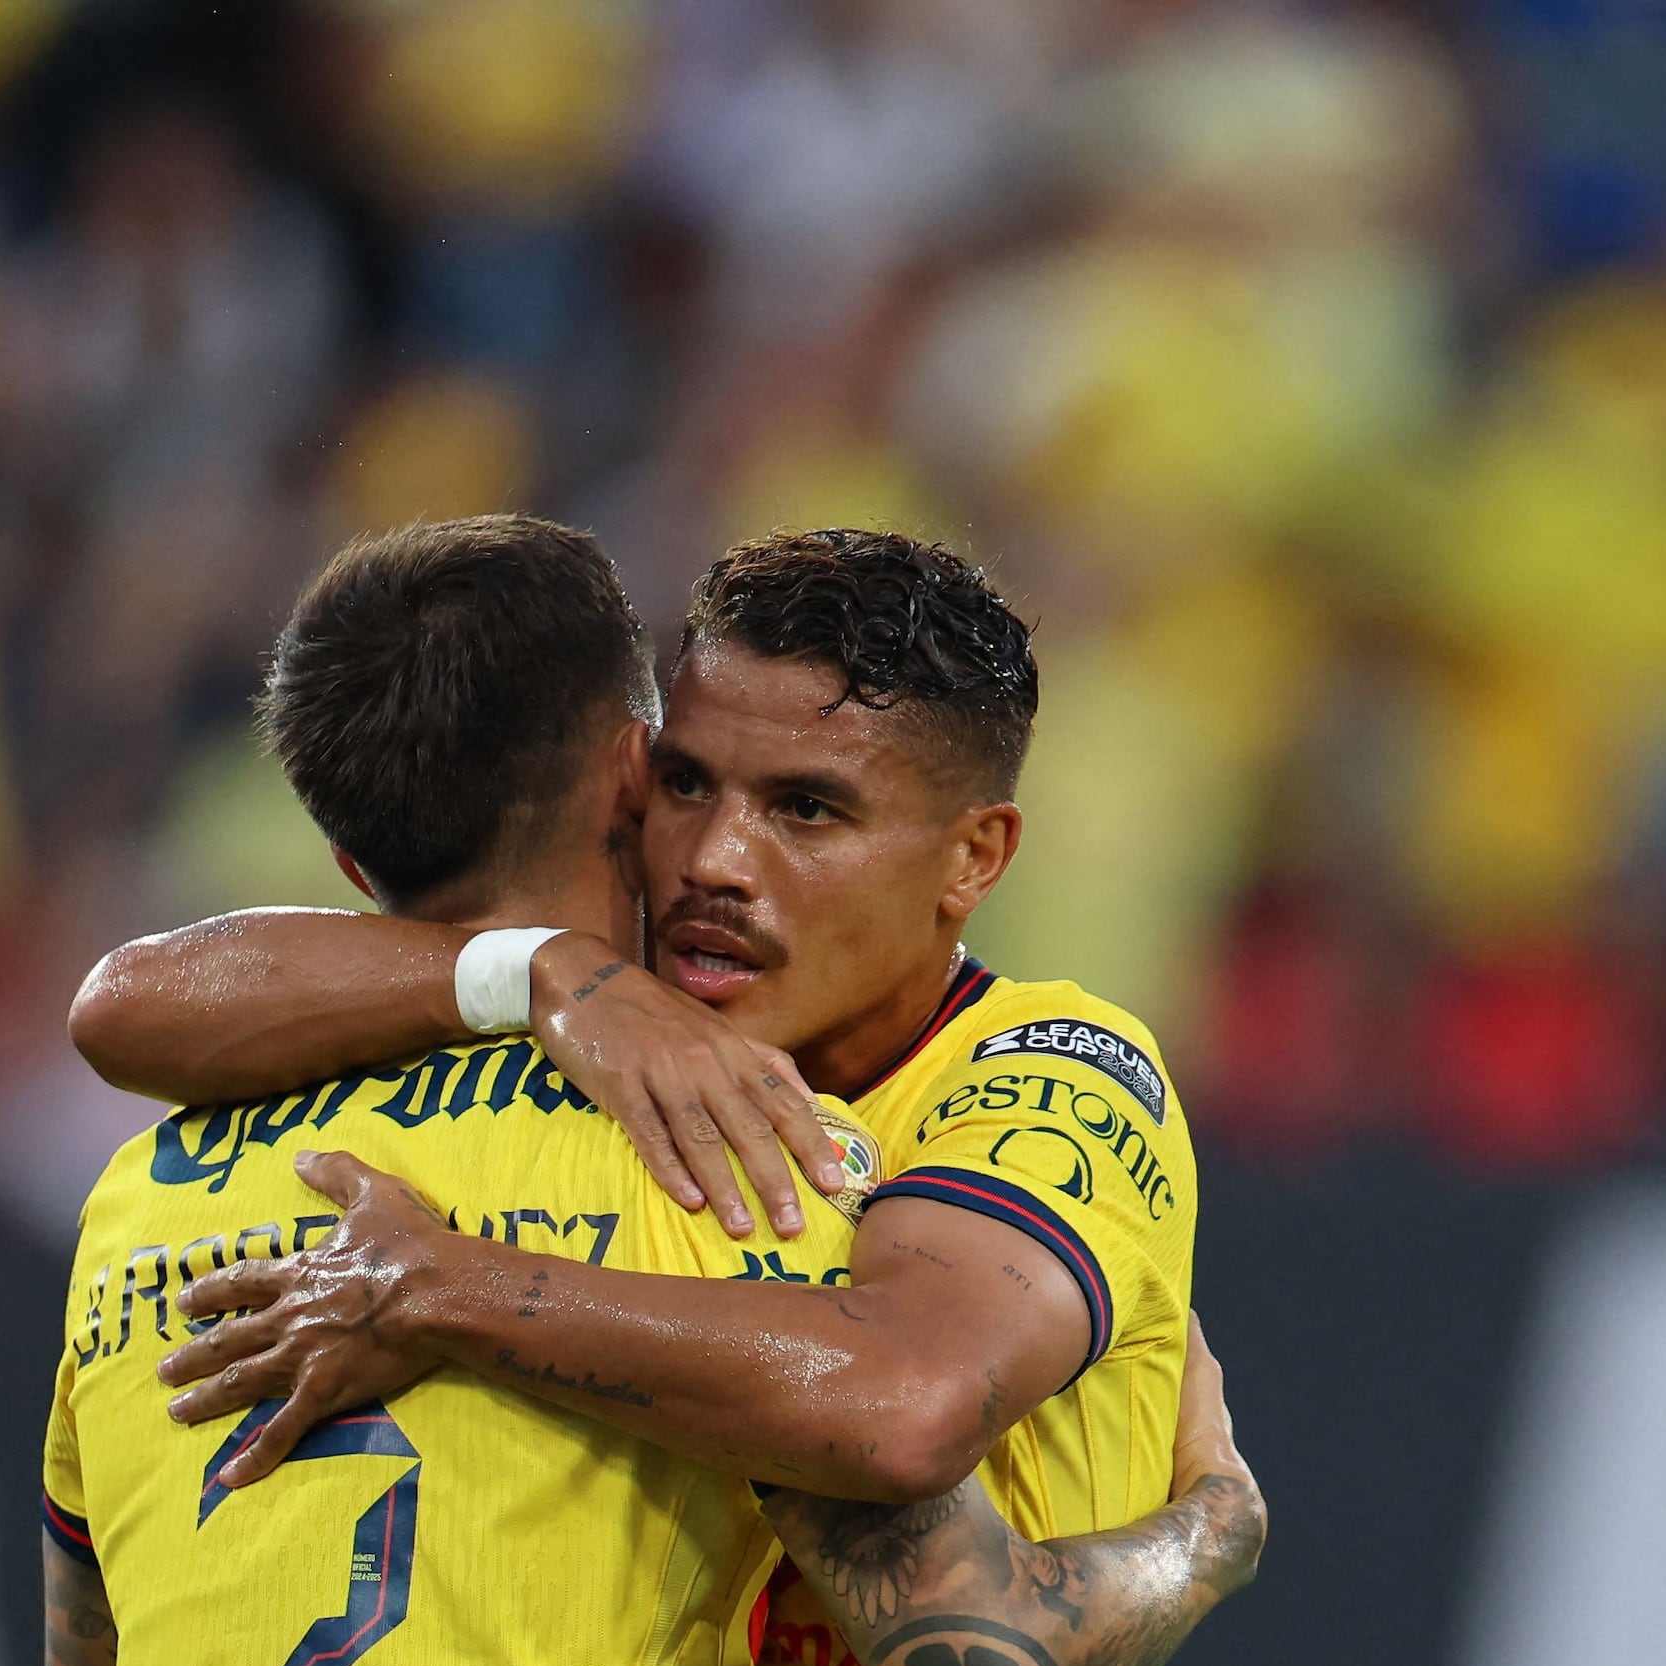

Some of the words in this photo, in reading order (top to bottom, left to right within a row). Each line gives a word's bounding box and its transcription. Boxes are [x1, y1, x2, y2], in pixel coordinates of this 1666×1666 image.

[1025, 1035, 1099, 1056] CUP
[1097, 1051, 1161, 1113] 2024
[1028, 1023, 1163, 1096] LEAGUES
